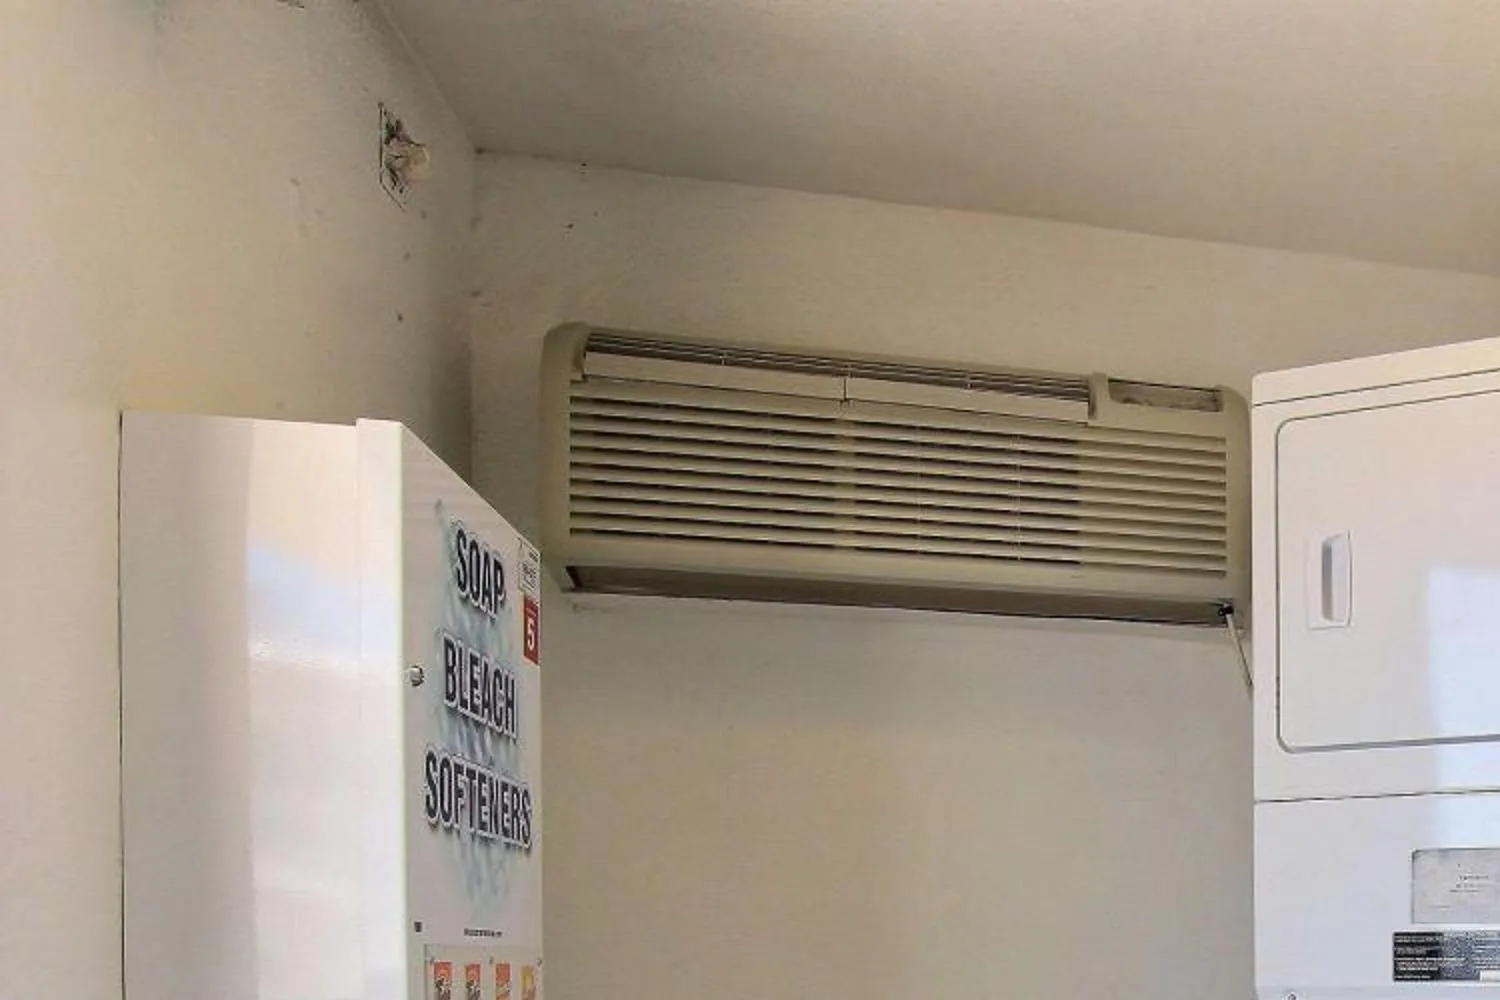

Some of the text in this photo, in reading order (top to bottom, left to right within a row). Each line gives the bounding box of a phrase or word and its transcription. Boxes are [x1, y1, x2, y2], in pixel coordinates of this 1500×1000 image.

[456, 527, 506, 617] SOAP
[525, 619, 536, 653] 5
[443, 635, 518, 740] BLEACH
[425, 750, 532, 849] SOFTENERS
